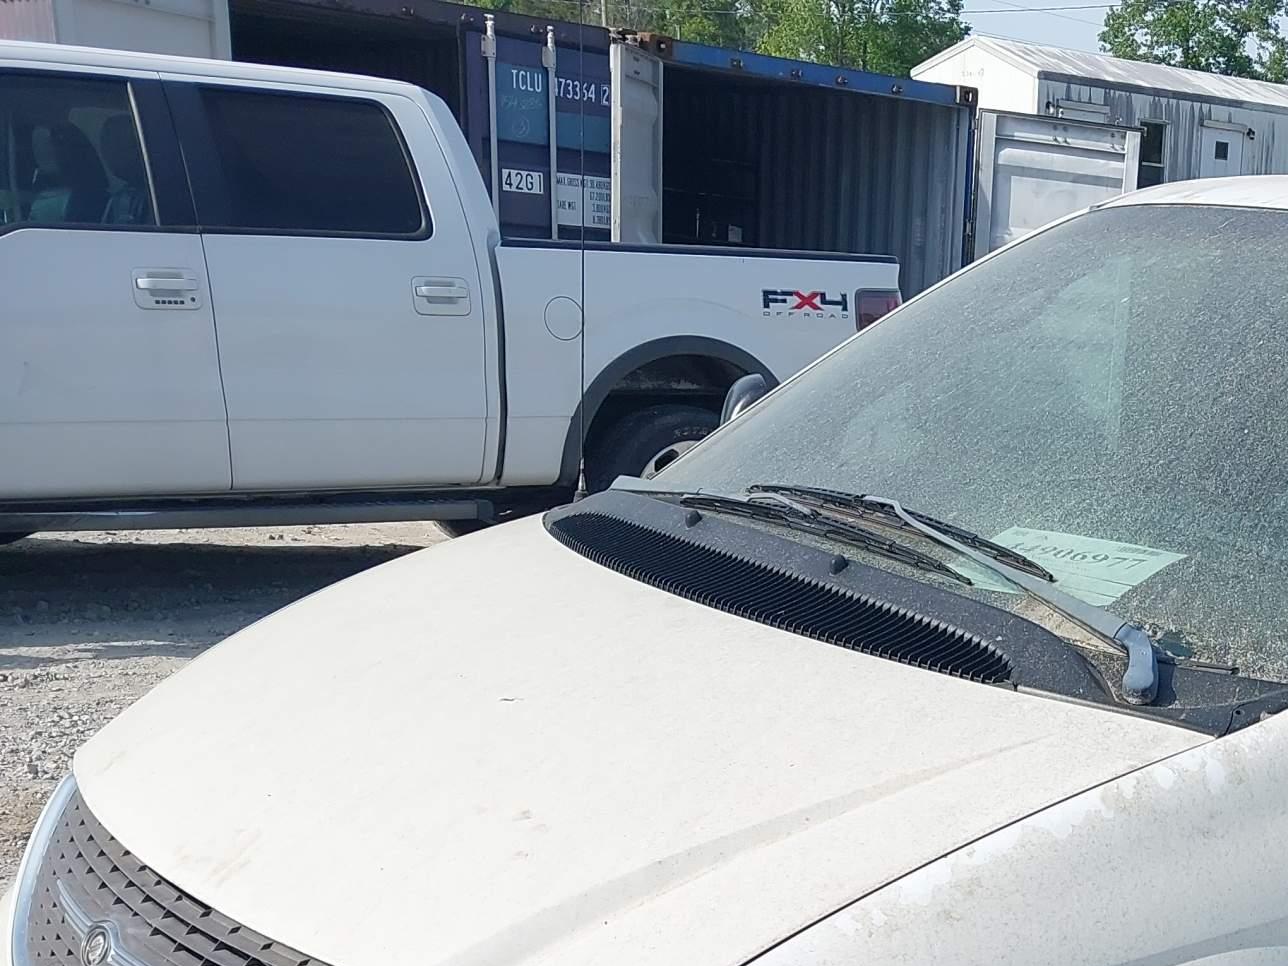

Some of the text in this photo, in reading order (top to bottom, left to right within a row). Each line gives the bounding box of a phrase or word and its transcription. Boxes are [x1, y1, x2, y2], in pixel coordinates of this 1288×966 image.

[511, 69, 542, 92] TCLU
[505, 171, 542, 193] 42G1
[762, 290, 848, 311] FX4
